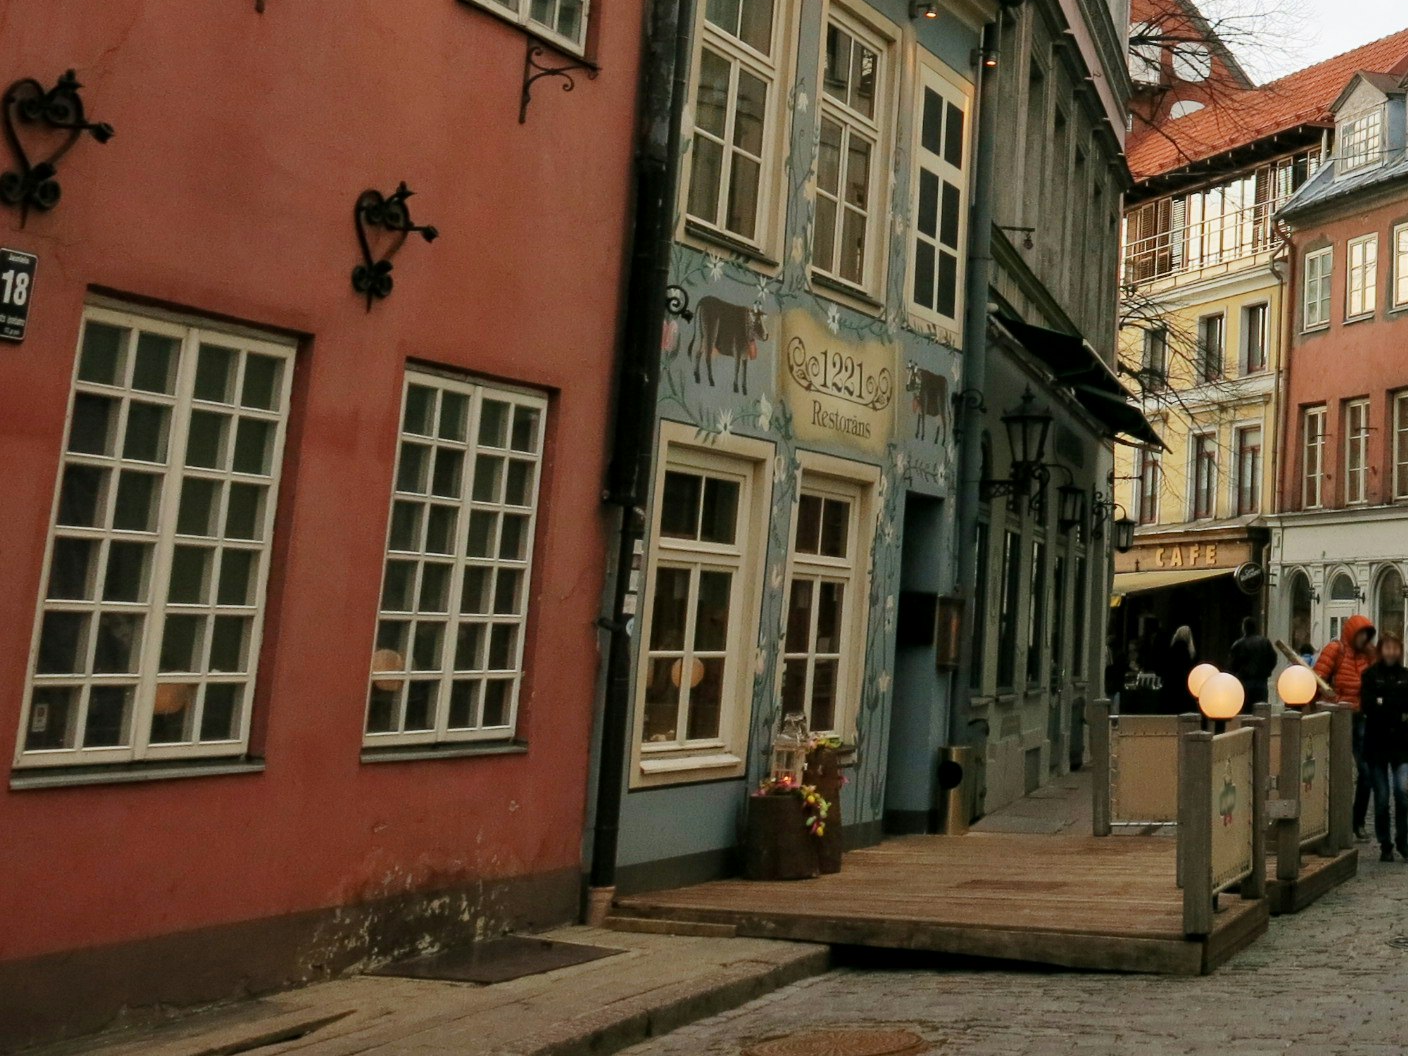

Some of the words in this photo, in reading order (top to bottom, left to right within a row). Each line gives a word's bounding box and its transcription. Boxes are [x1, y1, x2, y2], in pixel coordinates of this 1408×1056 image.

[1, 270, 30, 305] 18
[820, 349, 864, 399] 1221
[811, 400, 871, 439] Restorāns
[1155, 544, 1218, 567] CAFE
